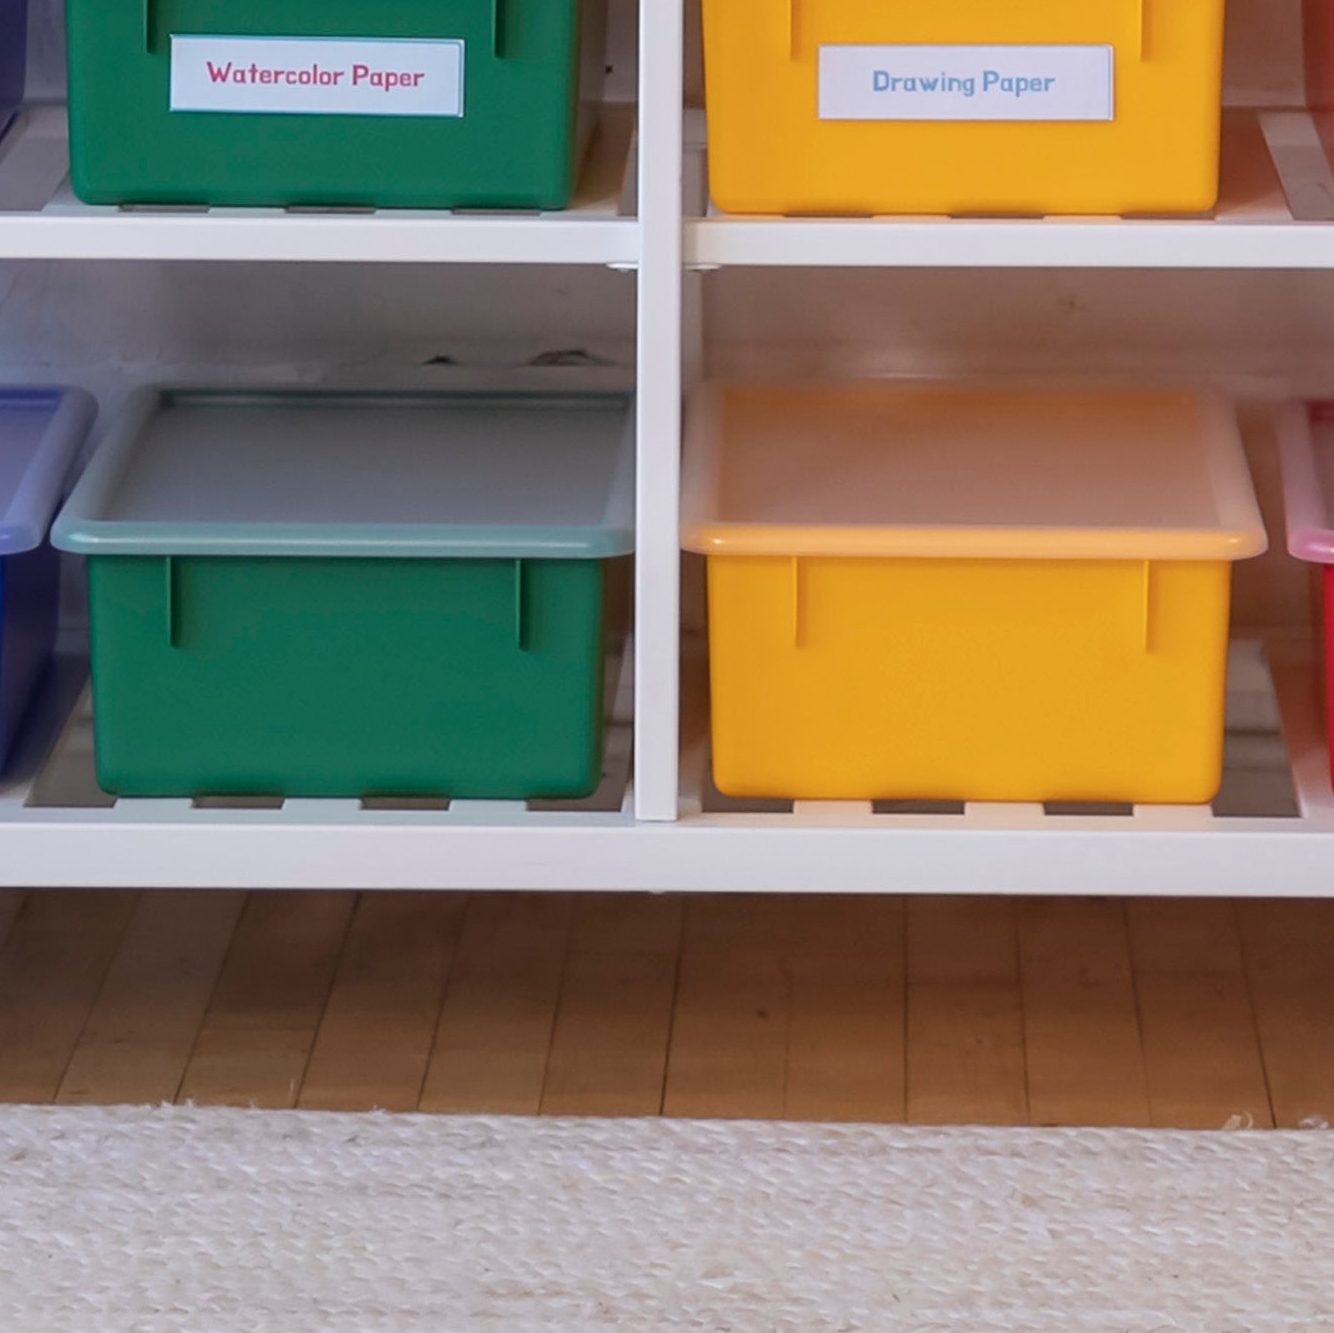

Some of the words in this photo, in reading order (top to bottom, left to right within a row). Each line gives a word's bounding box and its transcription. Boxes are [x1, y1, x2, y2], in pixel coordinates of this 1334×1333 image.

[206, 61, 344, 86] Watercolor
[352, 65, 425, 92] Paper
[873, 70, 975, 97] Drawing
[982, 70, 1056, 98] Paper
